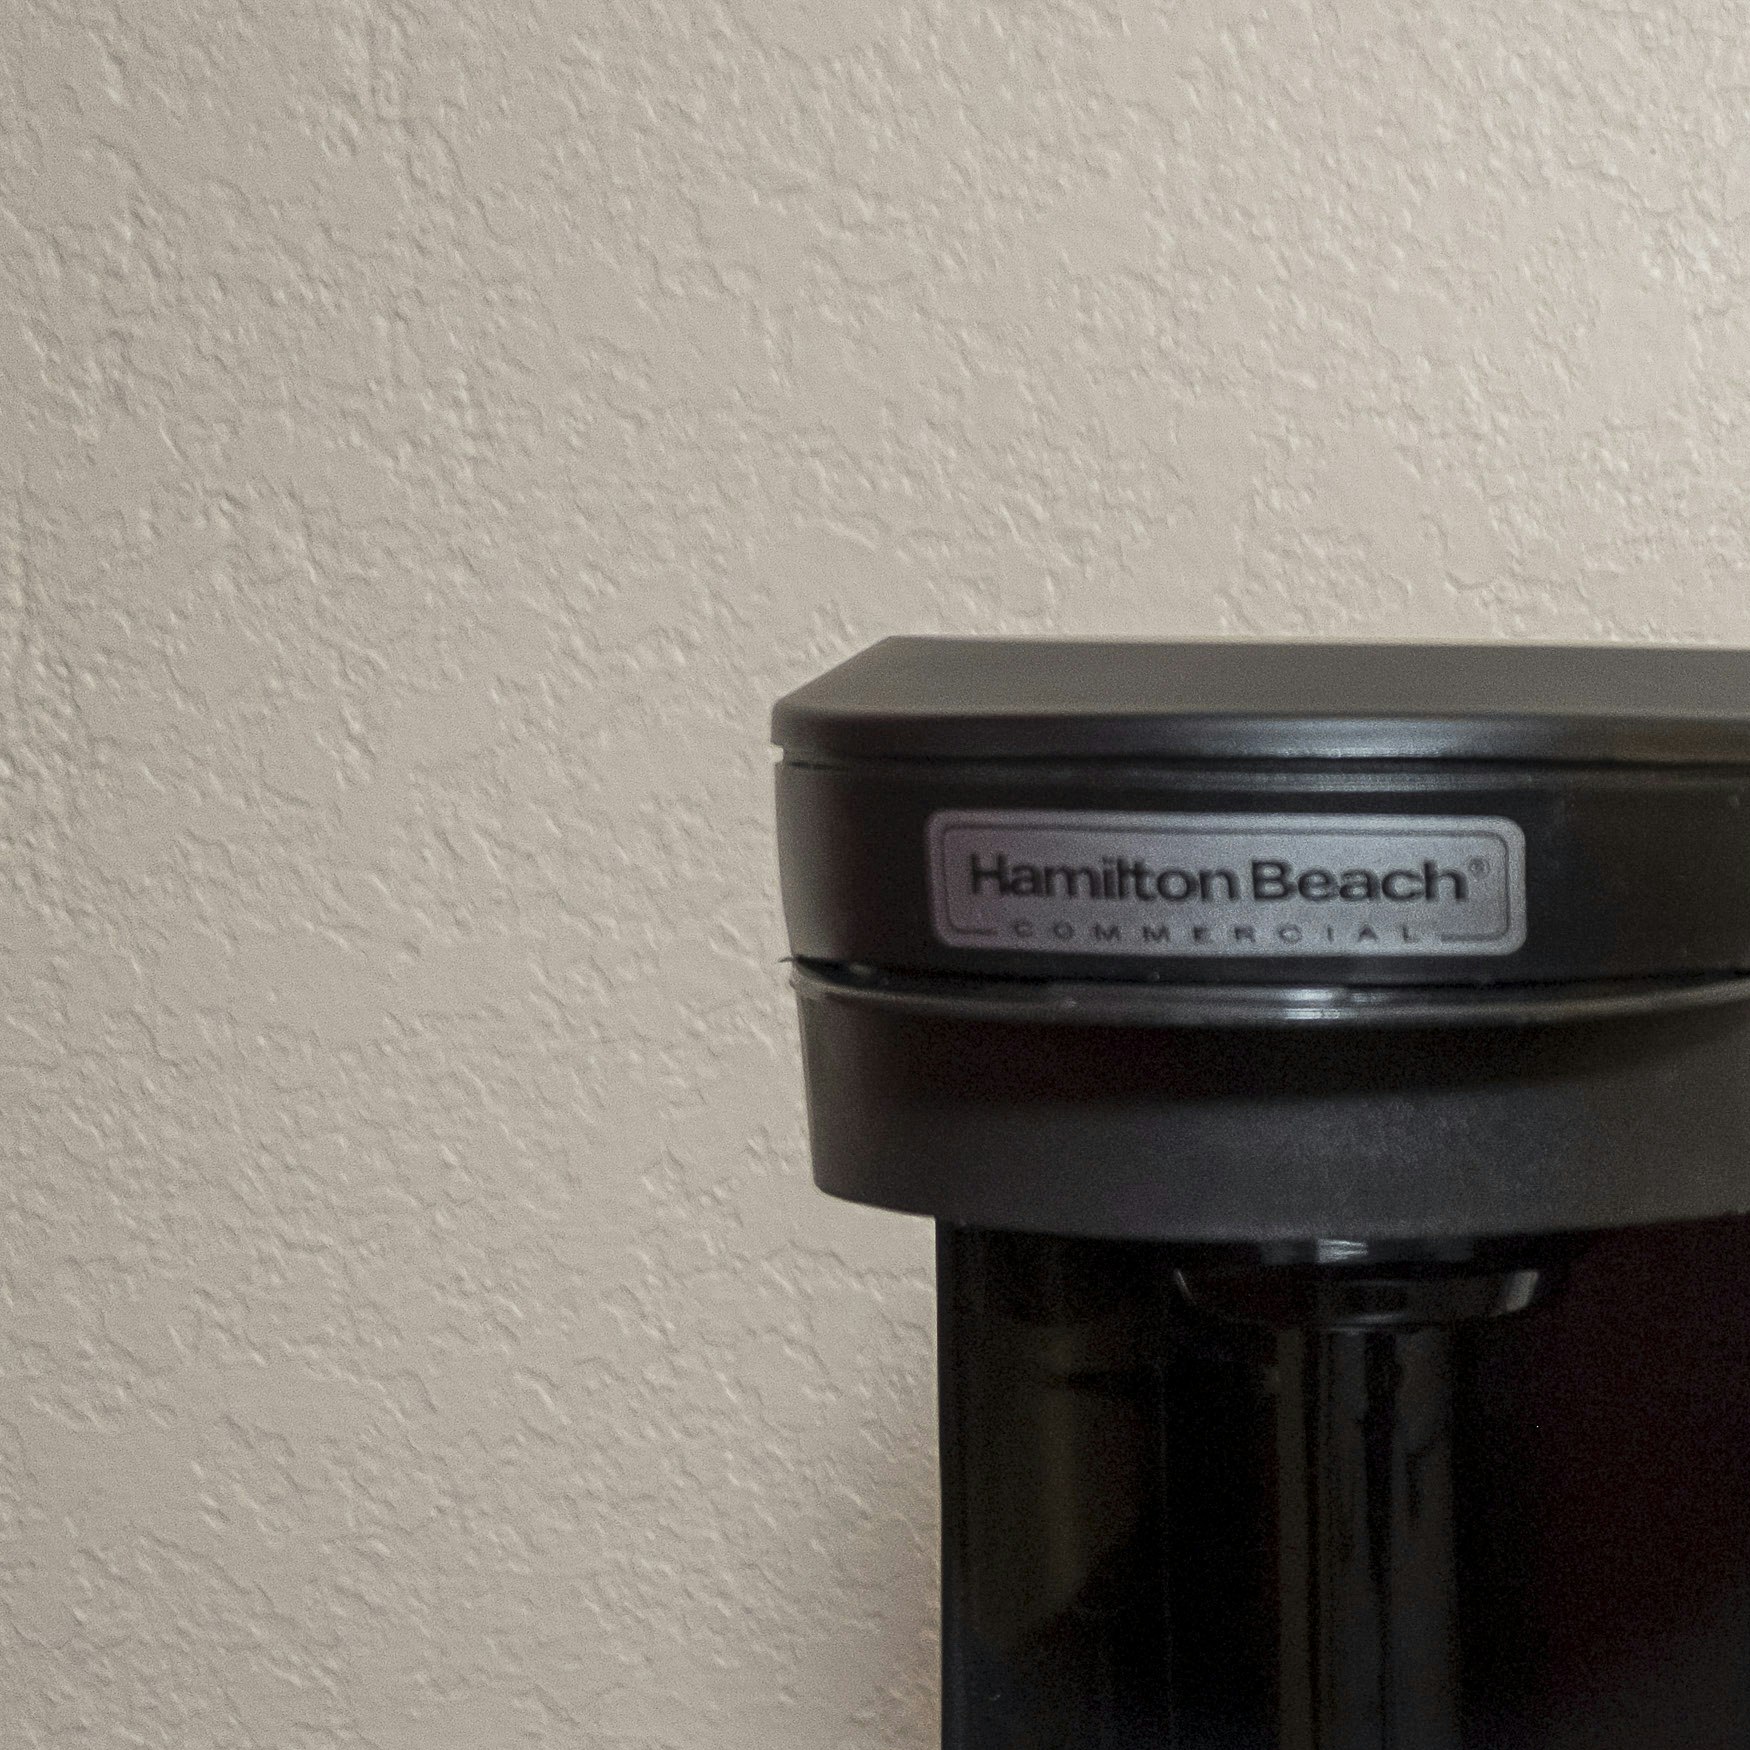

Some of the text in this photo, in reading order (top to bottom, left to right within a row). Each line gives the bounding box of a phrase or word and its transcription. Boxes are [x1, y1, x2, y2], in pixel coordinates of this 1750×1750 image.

[968, 854, 1469, 902] Hamilton Beach
[1013, 920, 1420, 945] COMMERCIAL
